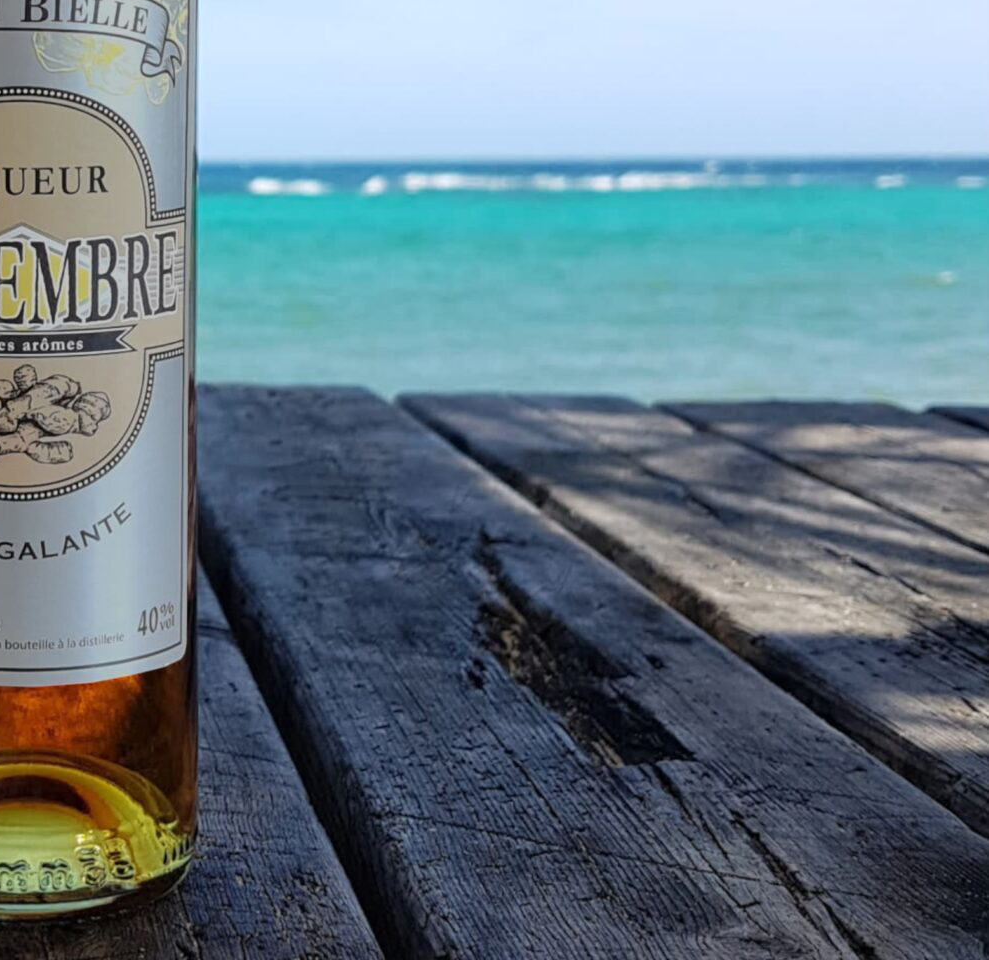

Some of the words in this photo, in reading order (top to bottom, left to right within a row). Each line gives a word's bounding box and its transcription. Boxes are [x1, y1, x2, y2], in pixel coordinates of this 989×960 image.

[22, 337, 84, 352] arômes
[4, 639, 54, 650] bouteille
[57, 638, 64, 649] à
[67, 638, 76, 648] la
[79, 632, 124, 648] distillerie
